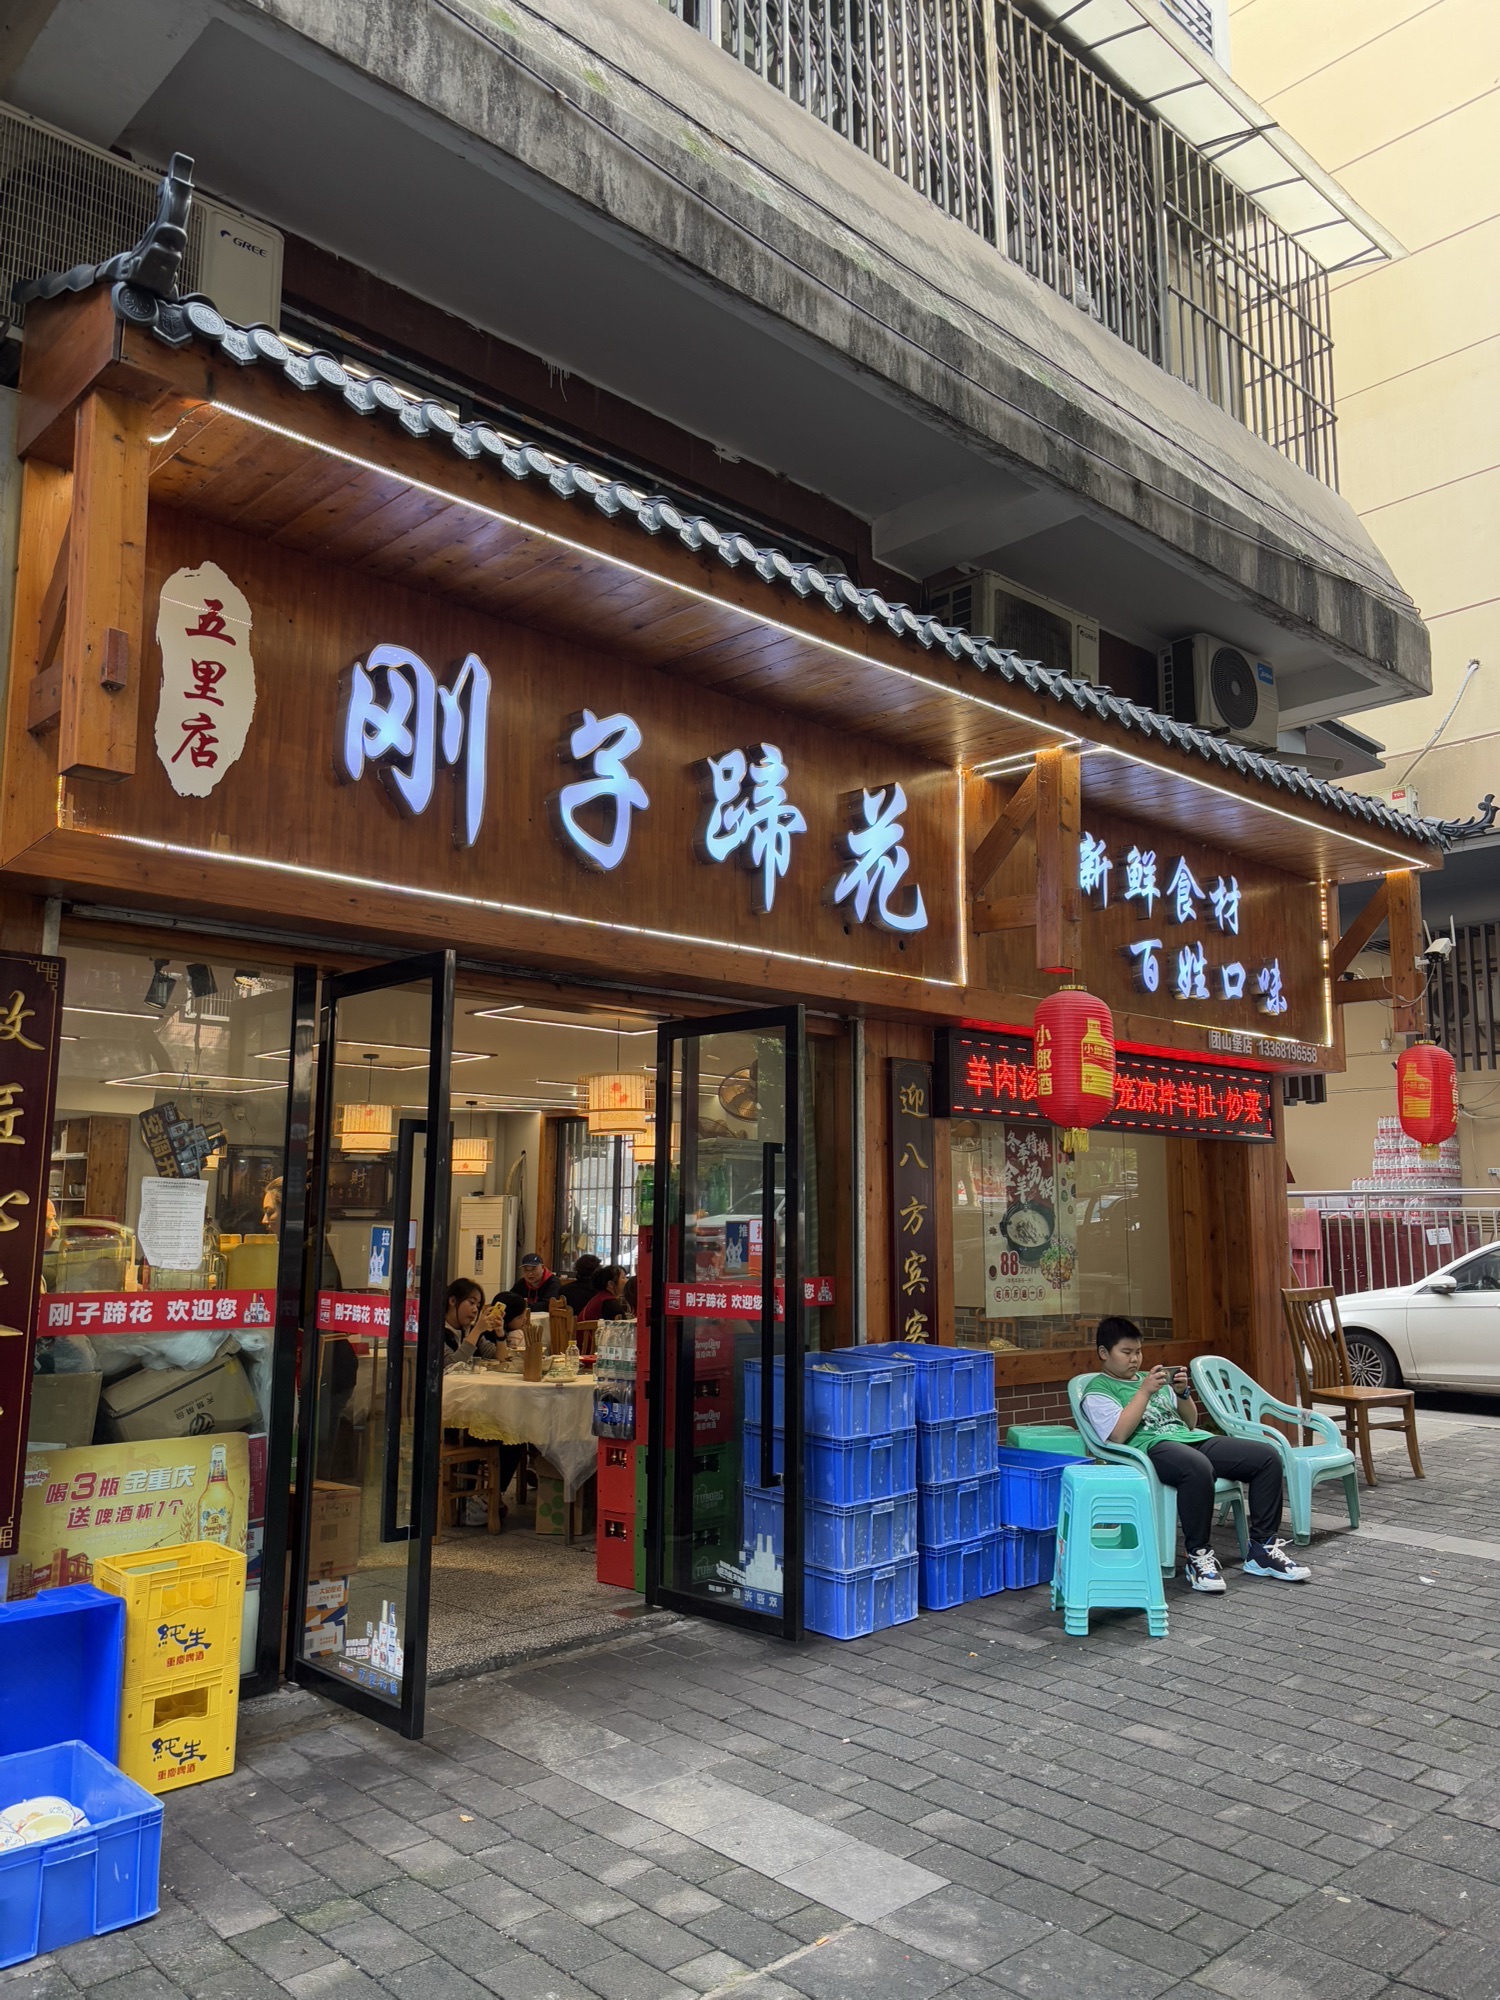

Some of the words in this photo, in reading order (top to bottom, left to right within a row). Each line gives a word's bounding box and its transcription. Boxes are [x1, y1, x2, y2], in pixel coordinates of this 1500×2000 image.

[233, 237, 268, 258] GREE
[171, 598, 236, 769] 五里店
[345, 642, 928, 932] 刚子蹄花
[1080, 831, 1241, 935] 新鲜食材
[1130, 938, 1288, 1015] 百姓口味
[1036, 1024, 1053, 1096] 小郎酒
[1209, 1030, 1253, 1054] 团山堡店
[1258, 1039, 1318, 1063] 13368196558
[142, 1113, 180, 1178] 空调开
[382, 1230, 390, 1246] 拉
[900, 1082, 929, 1344] 迎八方宾客
[48, 1300, 153, 1327] 刚子蹄花
[166, 1297, 238, 1322] 欢迎您
[335, 1303, 370, 1324] 刚子蹄花
[686, 1292, 727, 1309] 刚子蹄花
